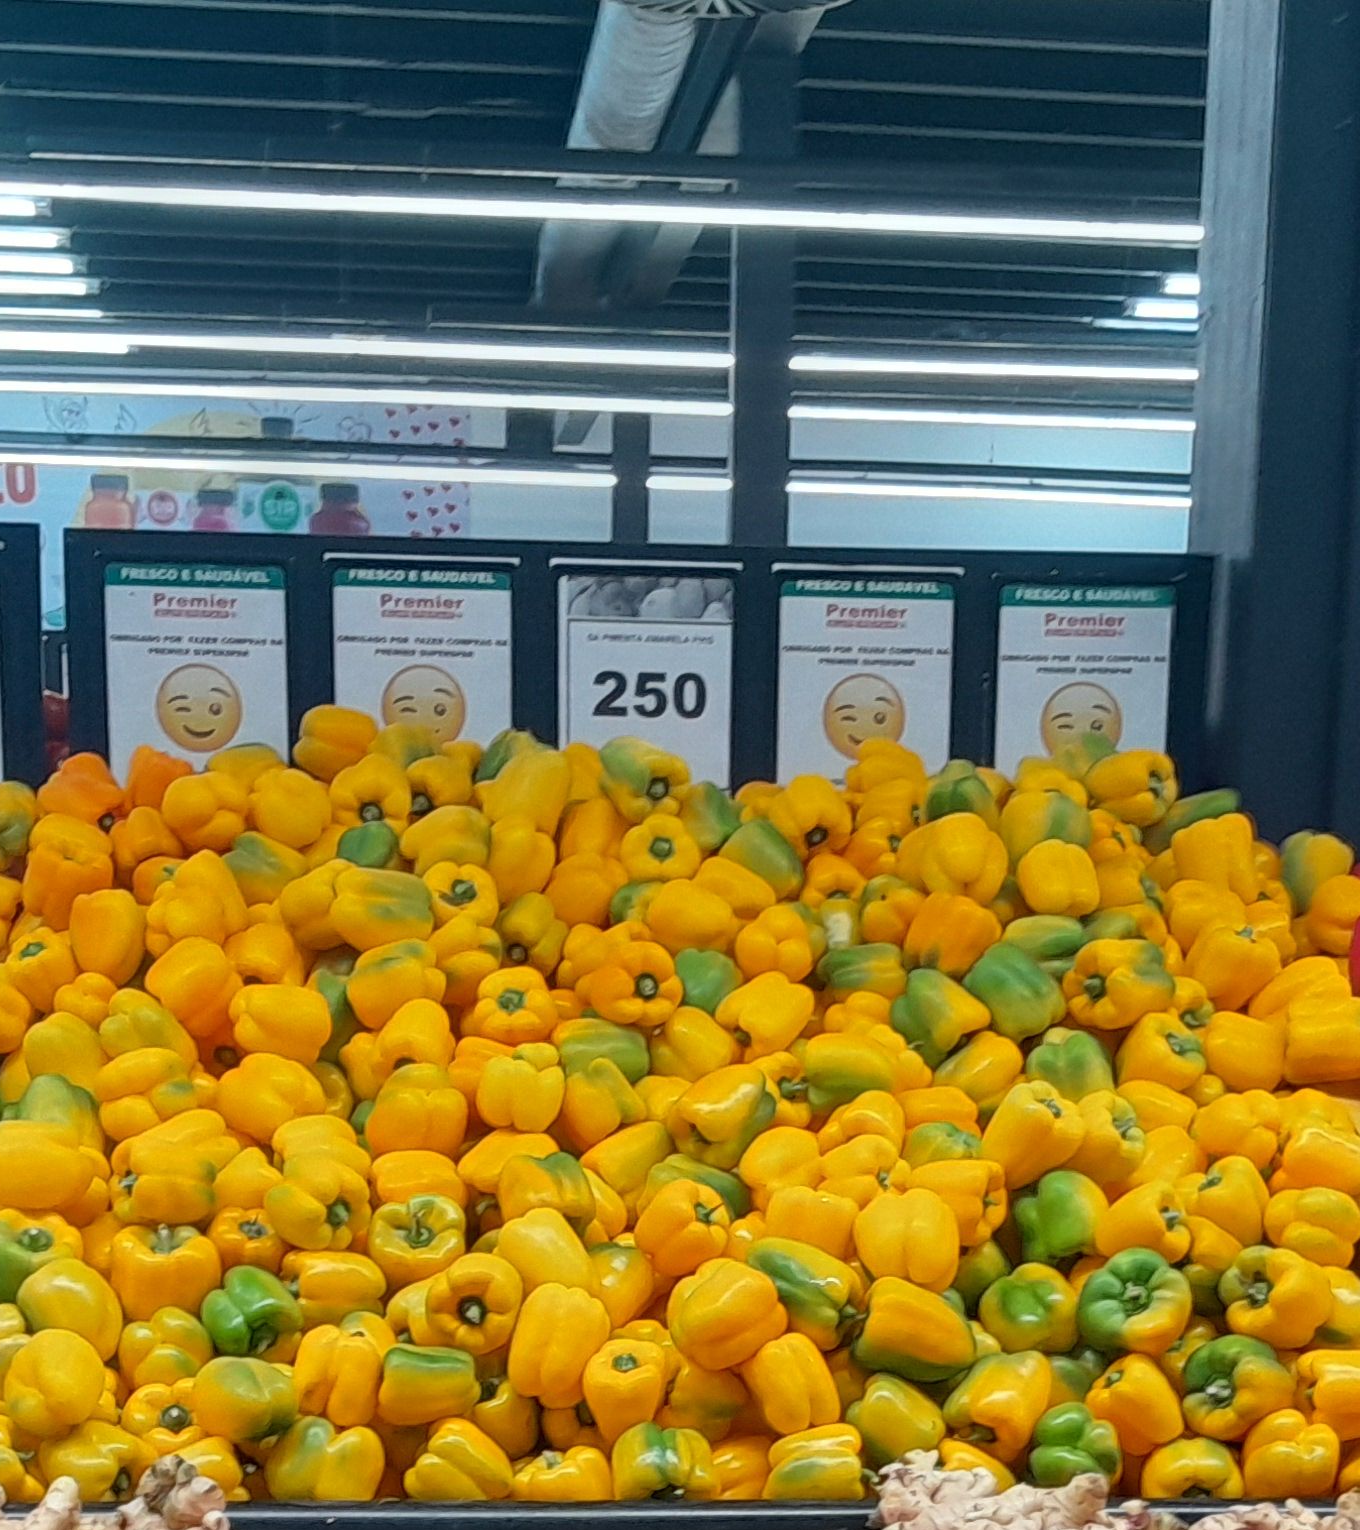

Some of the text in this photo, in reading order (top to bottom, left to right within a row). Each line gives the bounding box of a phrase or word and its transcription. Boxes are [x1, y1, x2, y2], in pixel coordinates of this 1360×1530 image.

[120, 567, 179, 580] FRESCO
[181, 569, 190, 580] E
[153, 593, 238, 609] Premier
[380, 593, 464, 609] Premier
[1015, 588, 1071, 601] FRESCO
[1072, 588, 1083, 601] E
[826, 604, 908, 619] Premier
[1045, 613, 1125, 627] Premier
[592, 670, 707, 719] 250
